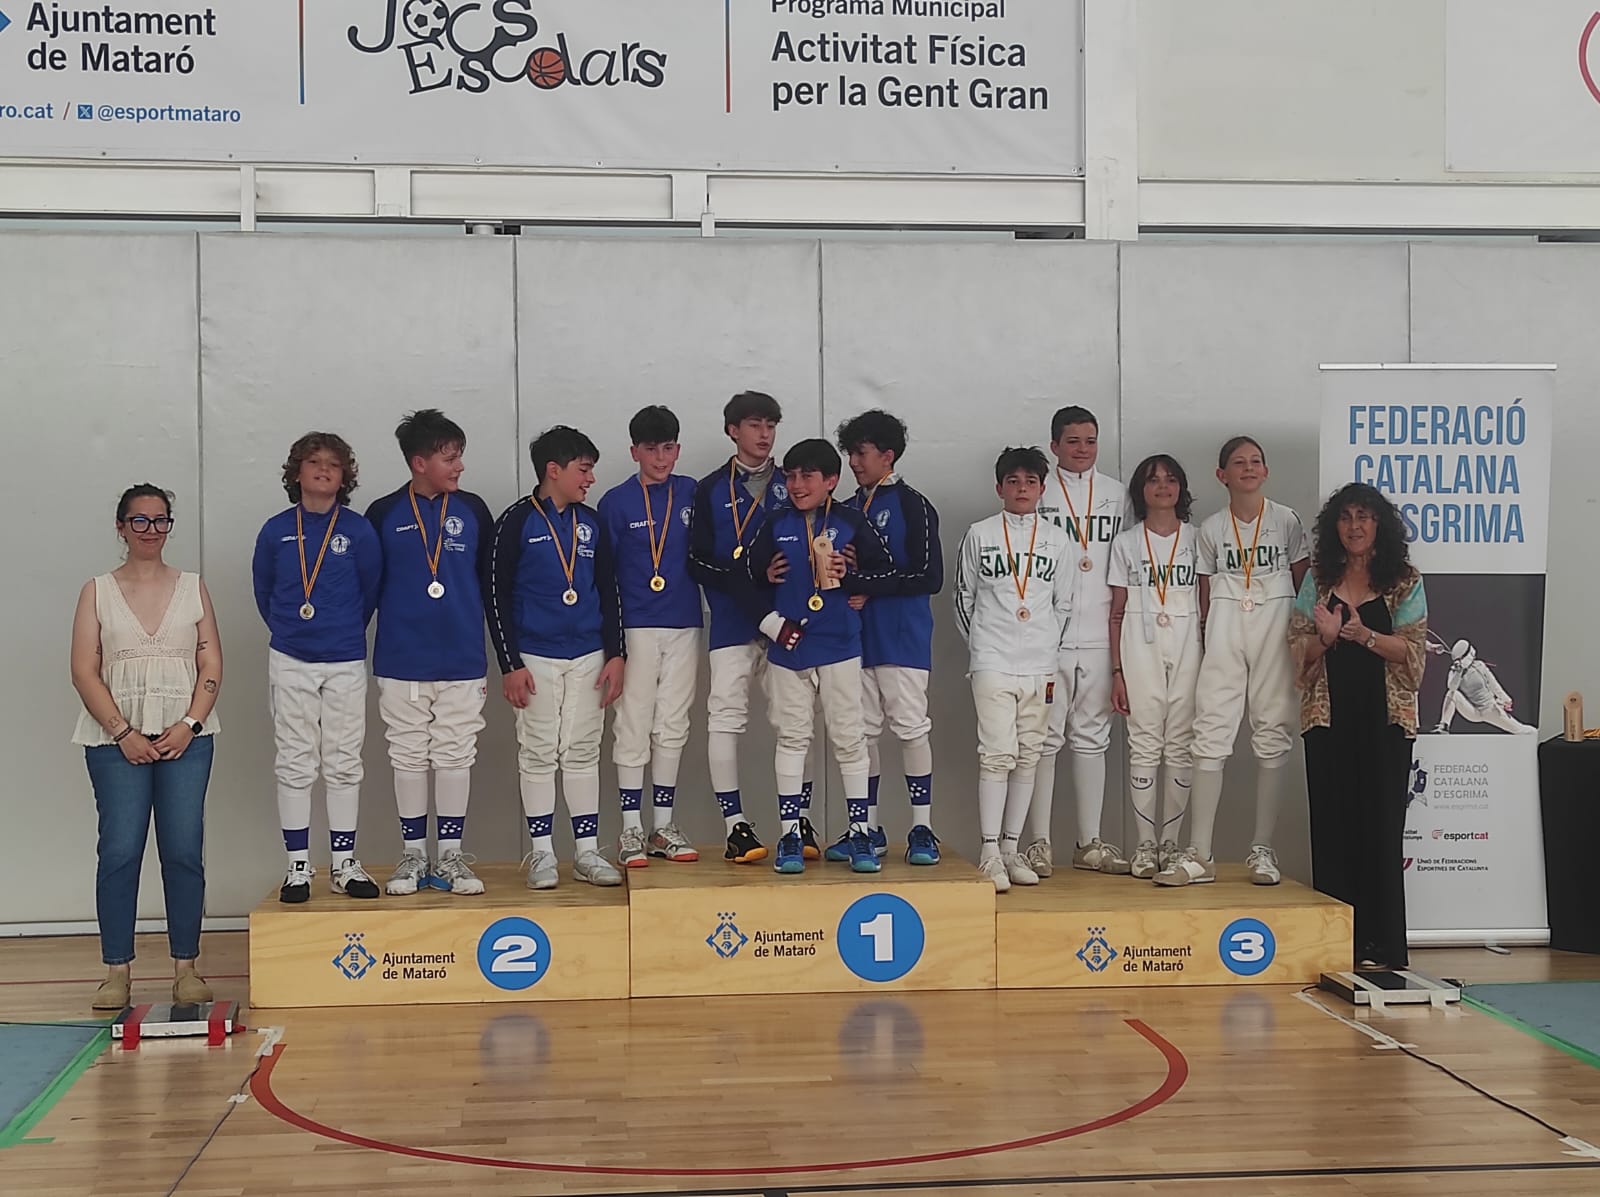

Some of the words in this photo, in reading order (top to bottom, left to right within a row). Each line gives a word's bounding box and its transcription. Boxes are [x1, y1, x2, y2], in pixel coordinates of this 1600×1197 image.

[27, 2, 216, 38] Ajuntament
[771, 0, 884, 18] Programa
[892, 0, 1005, 22] Municipal
[27, 42, 67, 70] de
[81, 43, 194, 73] Mataró
[771, 31, 917, 64] Activitat
[929, 35, 1026, 66] Física
[772, 81, 829, 111] per
[839, 75, 867, 105] la
[877, 76, 959, 107] Gent
[969, 78, 1048, 109] Gran
[98, 105, 241, 122] @esportmataro
[1349, 398, 1526, 446] FEDERACIÓ
[1354, 455, 1520, 494] CATALANA
[1395, 504, 1525, 543] SGRIMA
[1433, 777, 1489, 786] CATALANA
[1443, 832, 1489, 841] esportcat
[754, 929, 825, 944] Ajuntament
[860, 913, 894, 962] 1
[1229, 932, 1265, 962] 3
[382, 952, 456, 967] Ajuntament
[491, 935, 537, 972] 2
[754, 945, 769, 957] de
[774, 944, 816, 957] Mataró
[1123, 945, 1192, 959] Ajuntament
[382, 968, 398, 981] de
[402, 966, 447, 980] Mataró
[1123, 961, 1138, 973] de
[1142, 959, 1184, 973] Mataró
